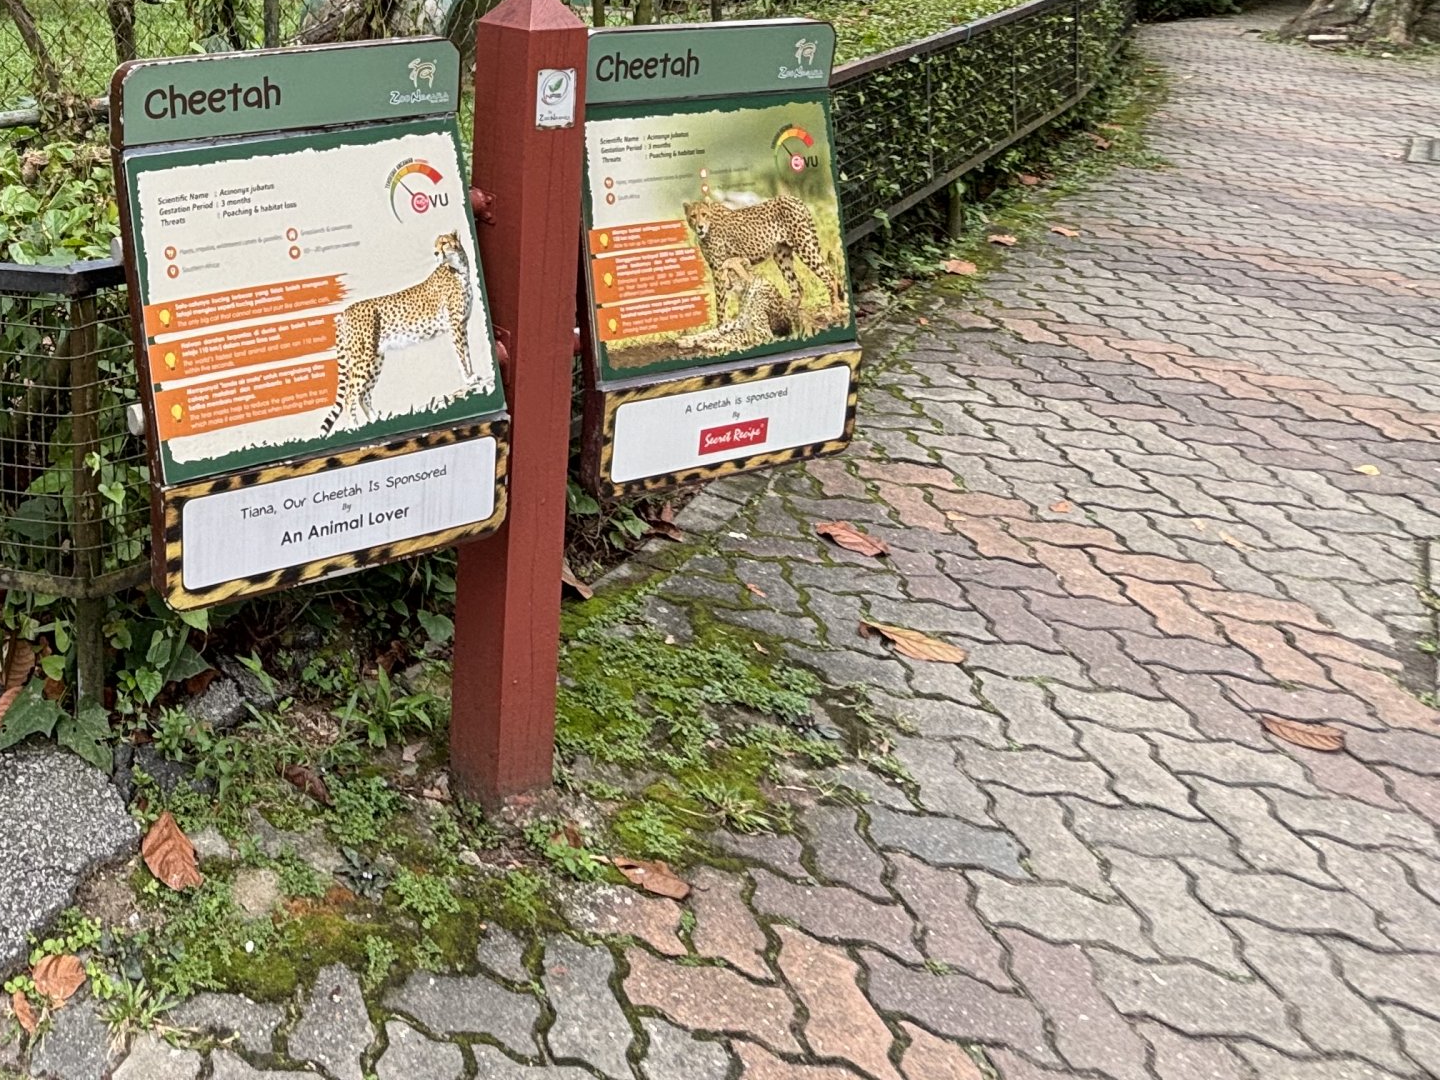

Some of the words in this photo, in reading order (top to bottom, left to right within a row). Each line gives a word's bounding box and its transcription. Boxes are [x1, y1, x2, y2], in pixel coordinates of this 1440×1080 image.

[596, 48, 699, 82] Cheetah
[144, 76, 281, 119] Cheetah
[624, 135, 639, 143] Name
[803, 156, 819, 168] VU
[158, 194, 188, 205] Scientific
[189, 192, 209, 201] Name
[220, 186, 250, 197] Acinonyx
[250, 183, 275, 194] jubatus
[429, 192, 449, 208] VU
[159, 205, 191, 216] Gestation
[192, 201, 213, 211] Period
[227, 197, 251, 206] months
[161, 217, 186, 227] Threats
[223, 208, 253, 218] Poaching
[261, 203, 283, 212] habitat
[284, 201, 297, 209] loss
[685, 405, 692, 414] A
[696, 397, 731, 412] Cheetah
[735, 397, 742, 405] is
[746, 387, 788, 404] sponsored
[732, 411, 740, 420] By
[704, 430, 732, 448] Secret
[733, 427, 761, 441] Recipe
[241, 504, 277, 520] Tiana,
[283, 496, 307, 510] Our
[313, 484, 362, 504] Cheetah
[368, 480, 380, 492] Is
[385, 465, 447, 489] Sponsored
[342, 502, 352, 513] By
[281, 530, 303, 546] An
[307, 514, 364, 540] Animal
[368, 506, 410, 526] Lover
